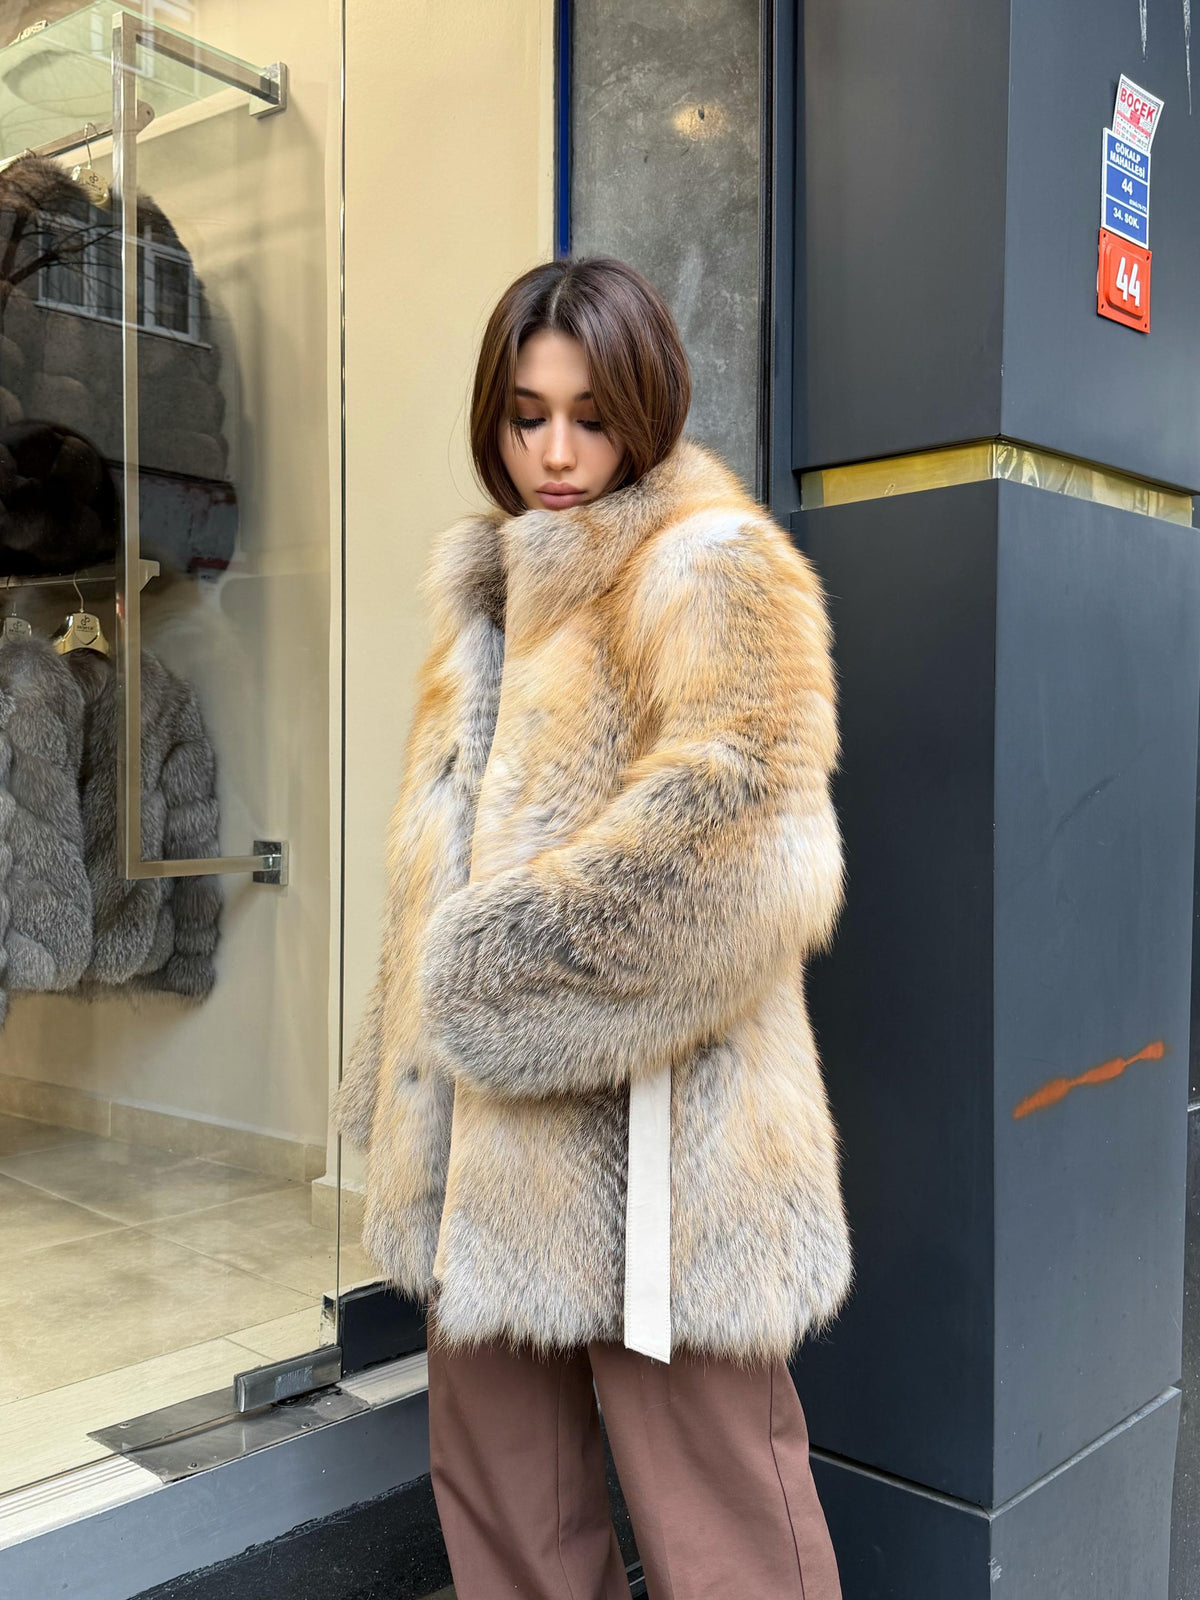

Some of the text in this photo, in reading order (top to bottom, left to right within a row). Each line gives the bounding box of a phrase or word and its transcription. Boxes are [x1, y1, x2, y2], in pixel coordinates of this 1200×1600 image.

[1115, 142, 1141, 164] GÖKALP
[1109, 151, 1145, 179] MAHALLESİ
[1121, 178, 1133, 195] 44
[1113, 207, 1140, 229] 34. SOK.
[1115, 256, 1141, 307] 44
